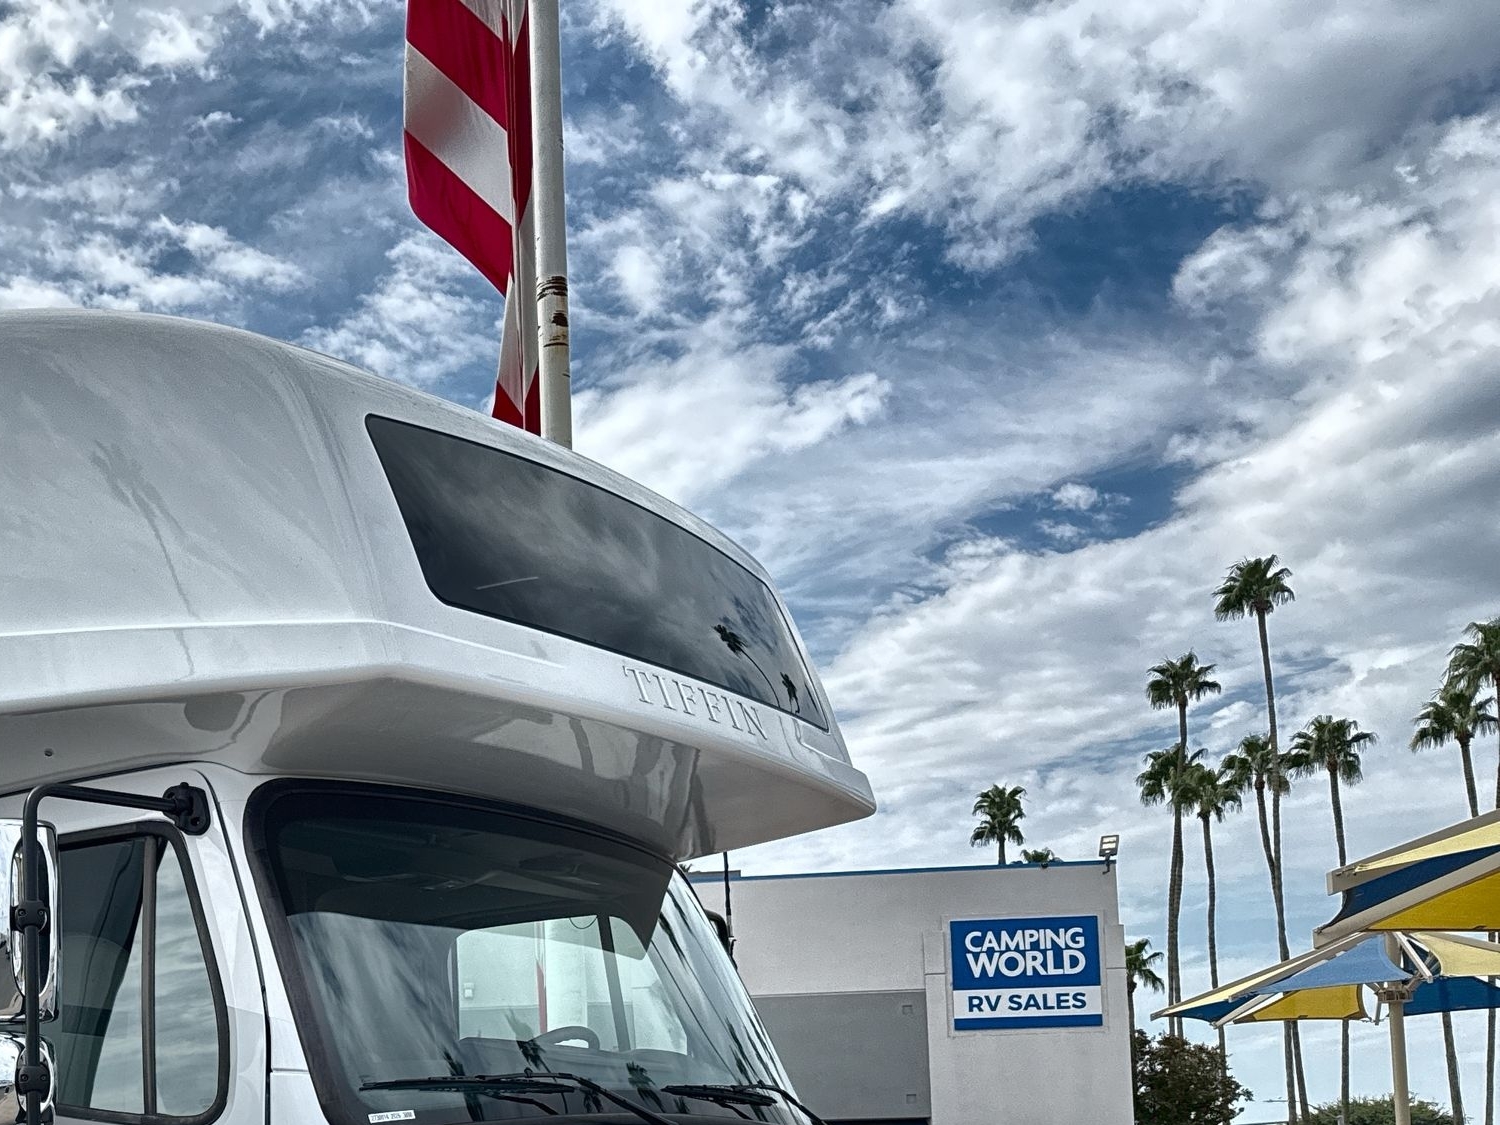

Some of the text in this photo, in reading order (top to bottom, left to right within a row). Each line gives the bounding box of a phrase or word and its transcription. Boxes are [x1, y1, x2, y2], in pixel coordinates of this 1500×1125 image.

[622, 665, 768, 740] TIFFIN
[964, 927, 1085, 952] CAMPING
[966, 949, 1086, 978] WORLD
[968, 992, 1087, 1012] RV SALES
